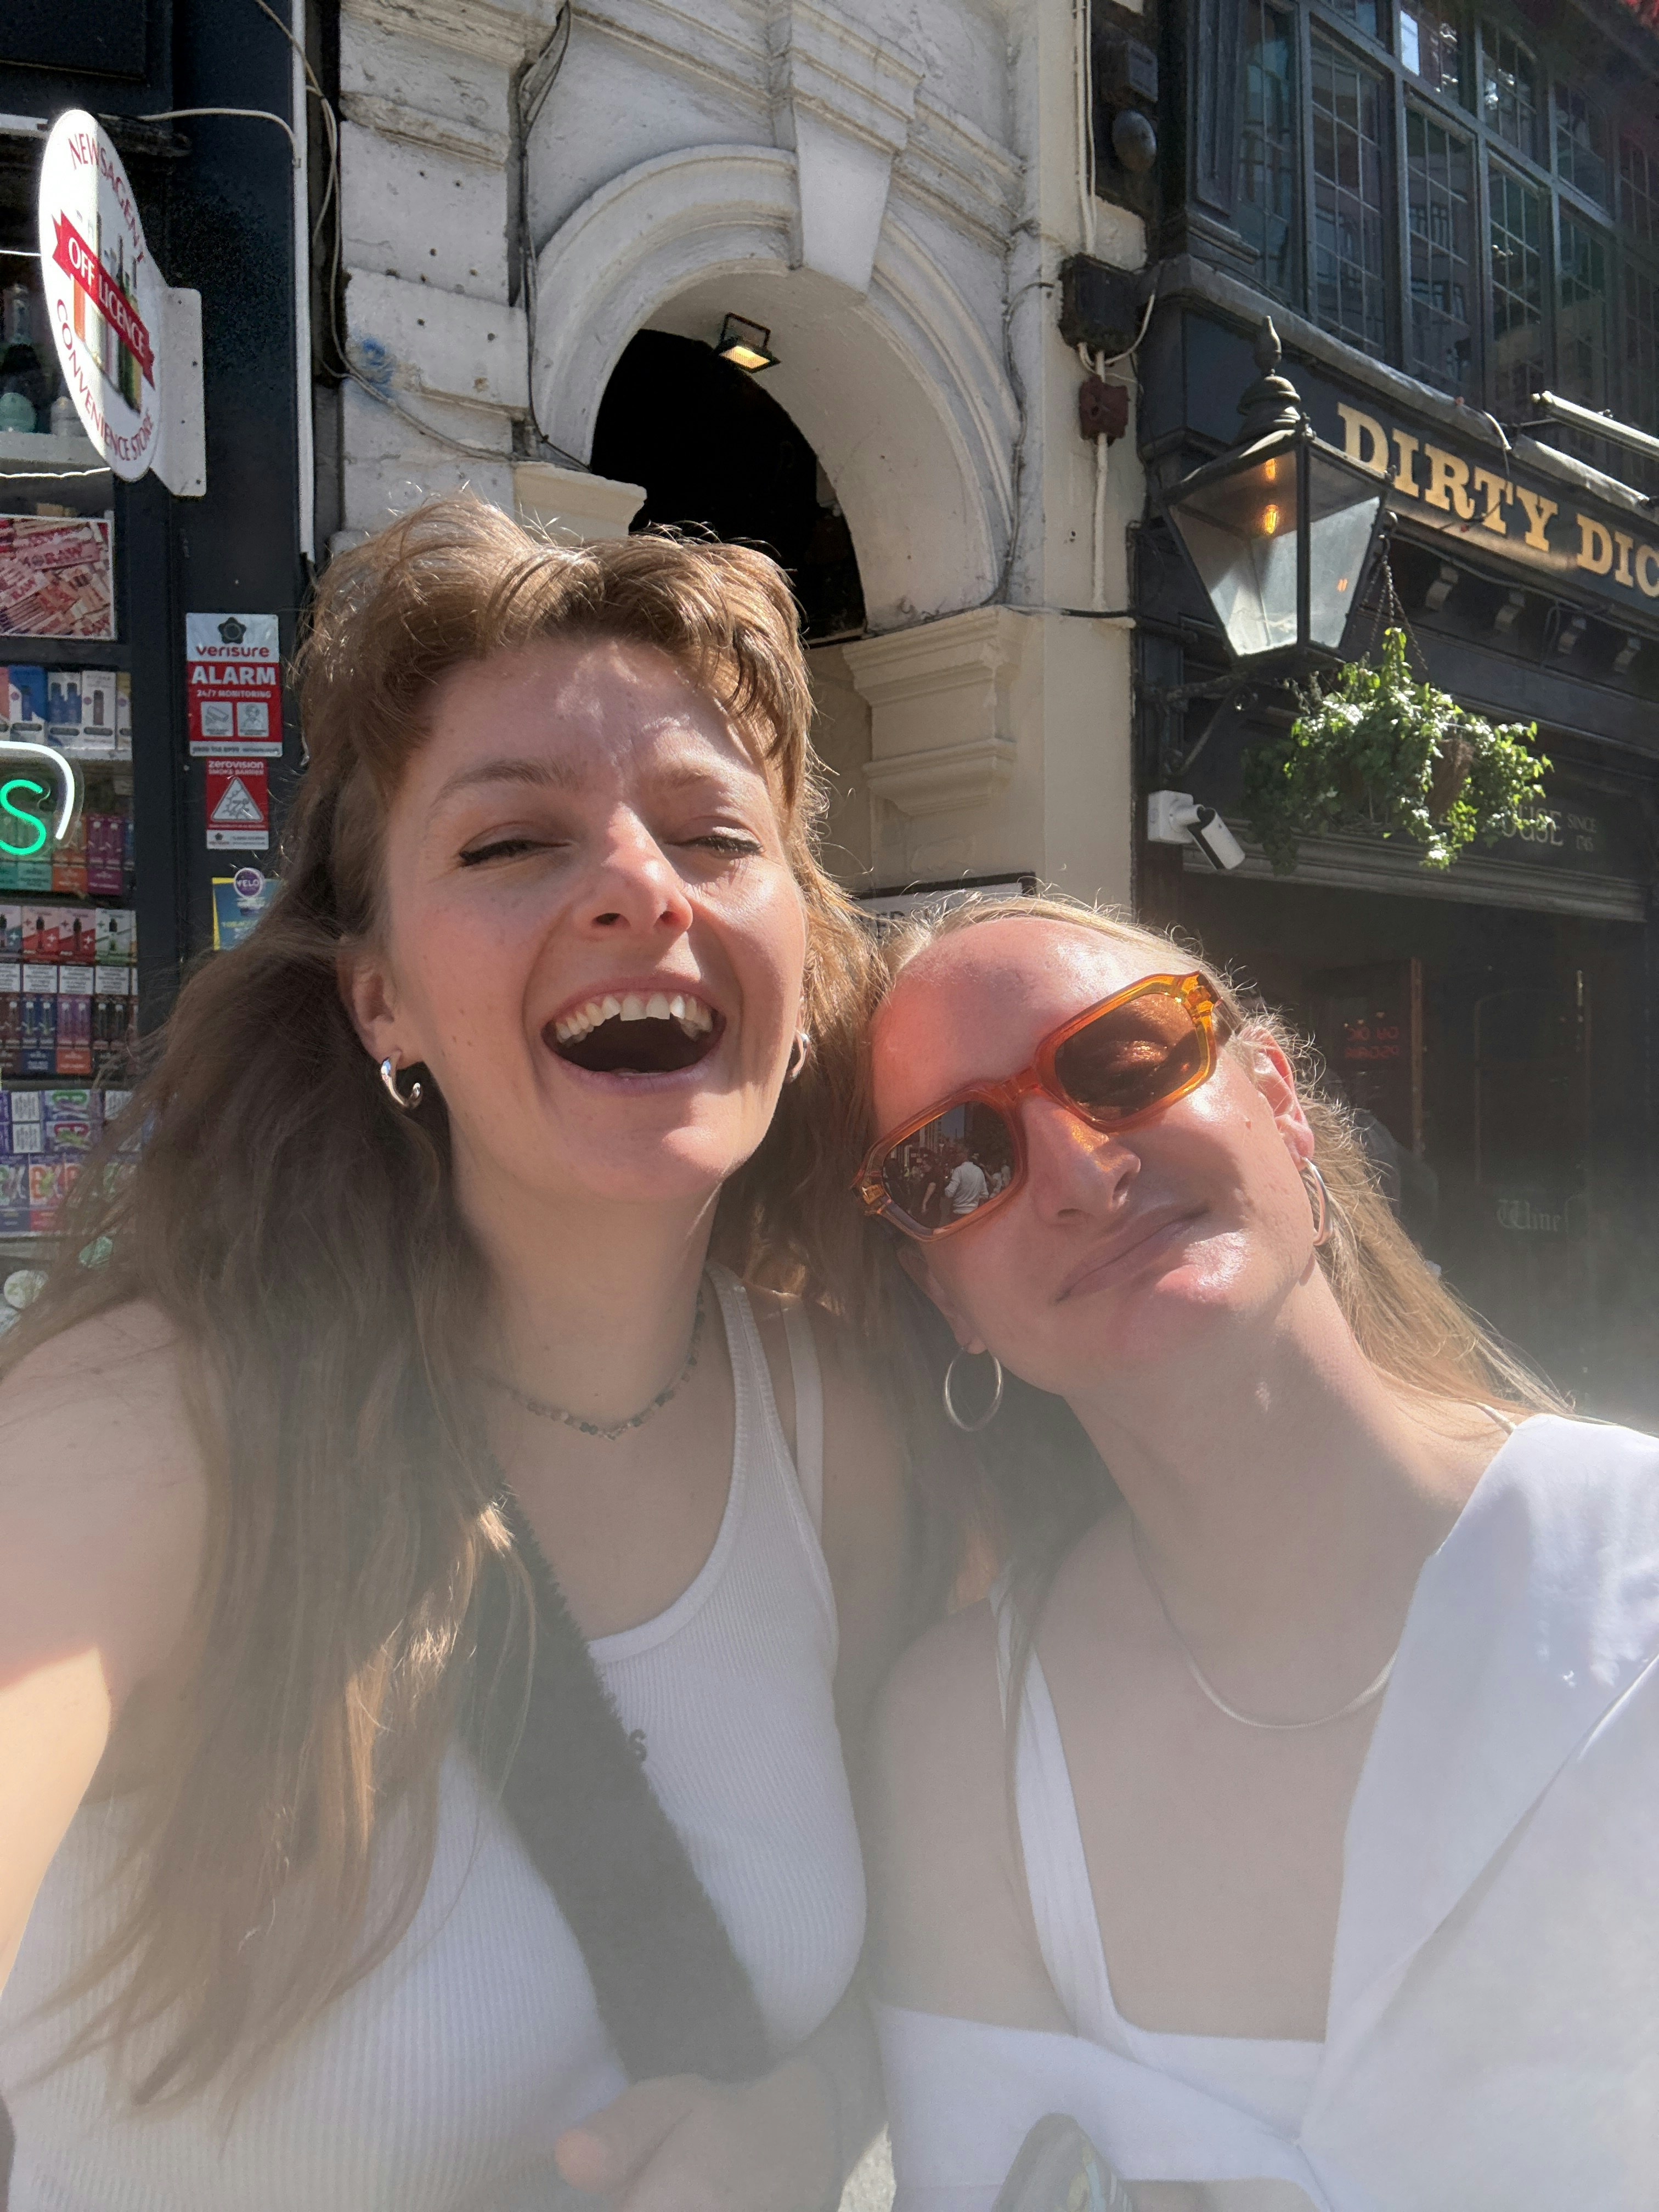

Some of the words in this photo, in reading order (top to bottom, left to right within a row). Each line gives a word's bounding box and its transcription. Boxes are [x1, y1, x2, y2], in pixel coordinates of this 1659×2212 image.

[68, 133, 144, 262] NEWSAGENT
[69, 237, 95, 286] OFF
[99, 274, 145, 358] LICENCE
[57, 299, 131, 461] CONVENIENCE
[131, 407, 154, 460] STORE
[1337, 402, 1558, 551] DIRTY
[192, 666, 276, 685] ALARM
[196, 646, 270, 657] verisure
[197, 690, 217, 698] 24/7
[218, 690, 272, 698] MONITORING
[236, 879, 259, 887] VELO
